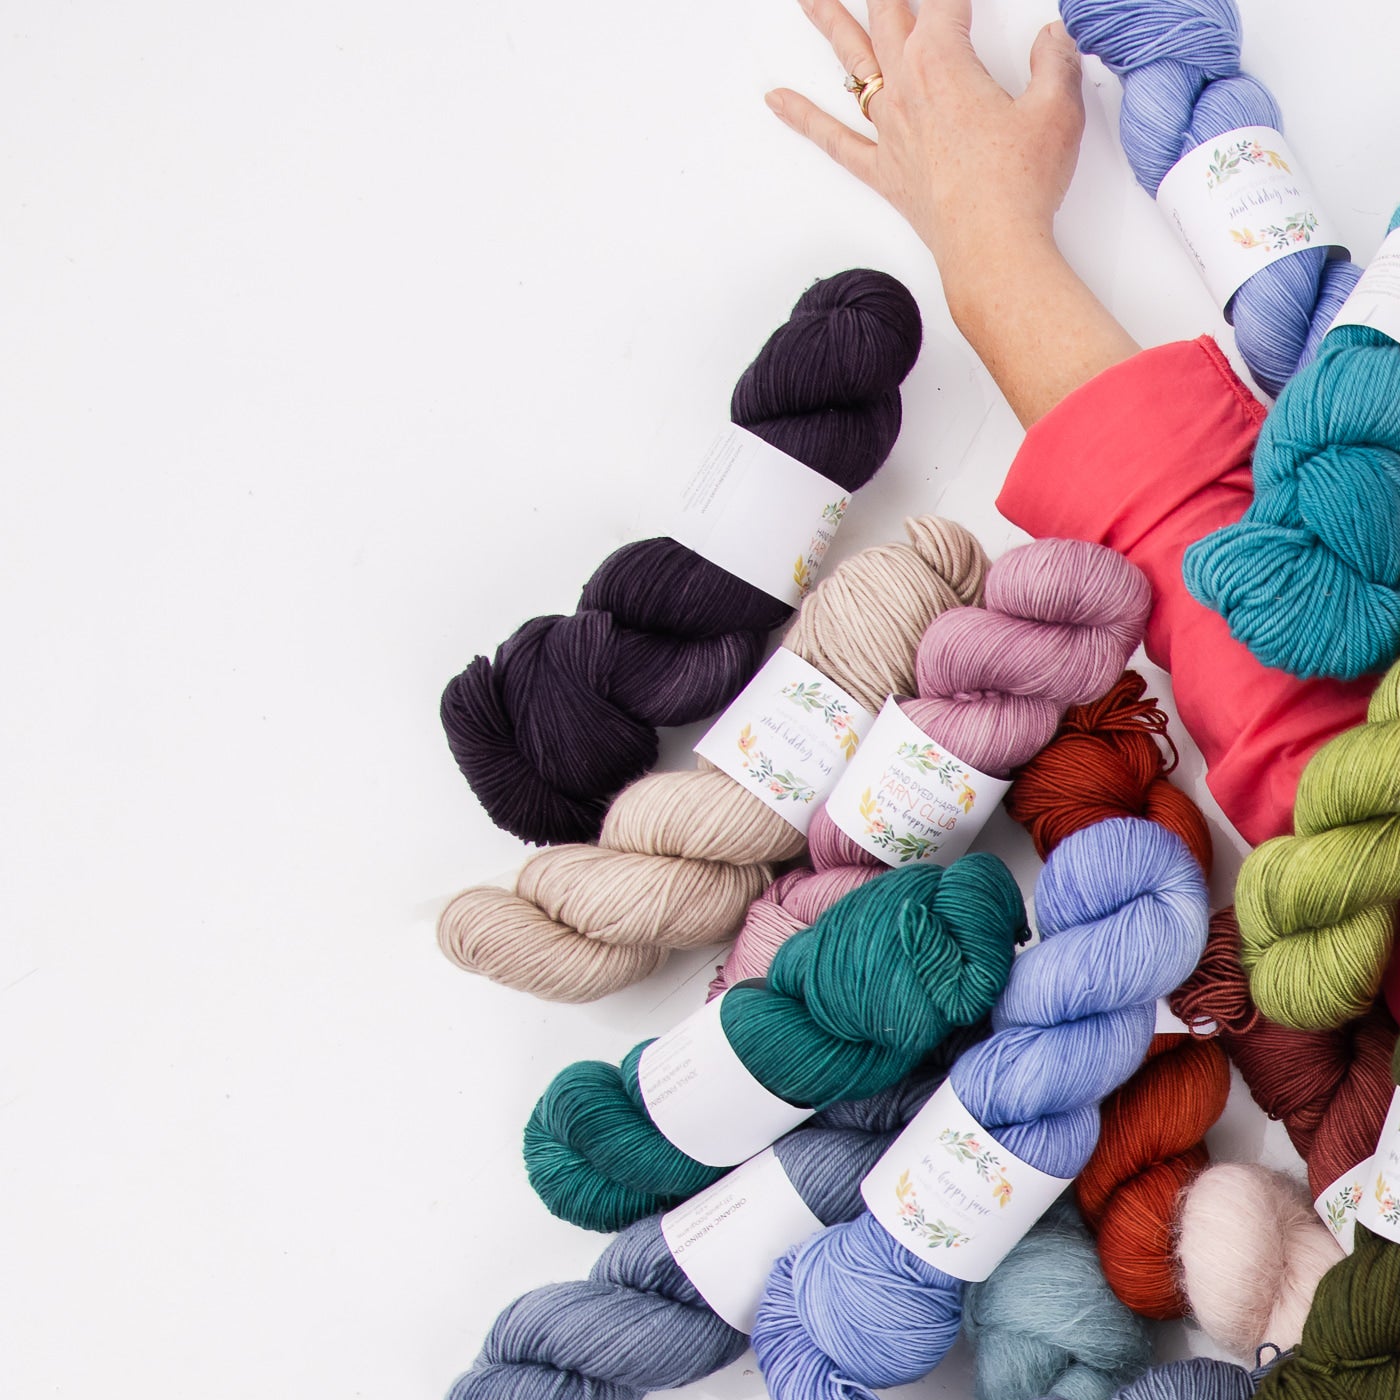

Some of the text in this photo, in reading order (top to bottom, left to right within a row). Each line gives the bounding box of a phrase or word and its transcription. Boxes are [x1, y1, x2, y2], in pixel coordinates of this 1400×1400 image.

[878, 773, 958, 831] YARN CLUB
[886, 765, 962, 817] HAND DYED HAPPY
[902, 809, 931, 833] happy
[715, 1198, 746, 1225] ORGANIC
[684, 1224, 714, 1247] MERINO
